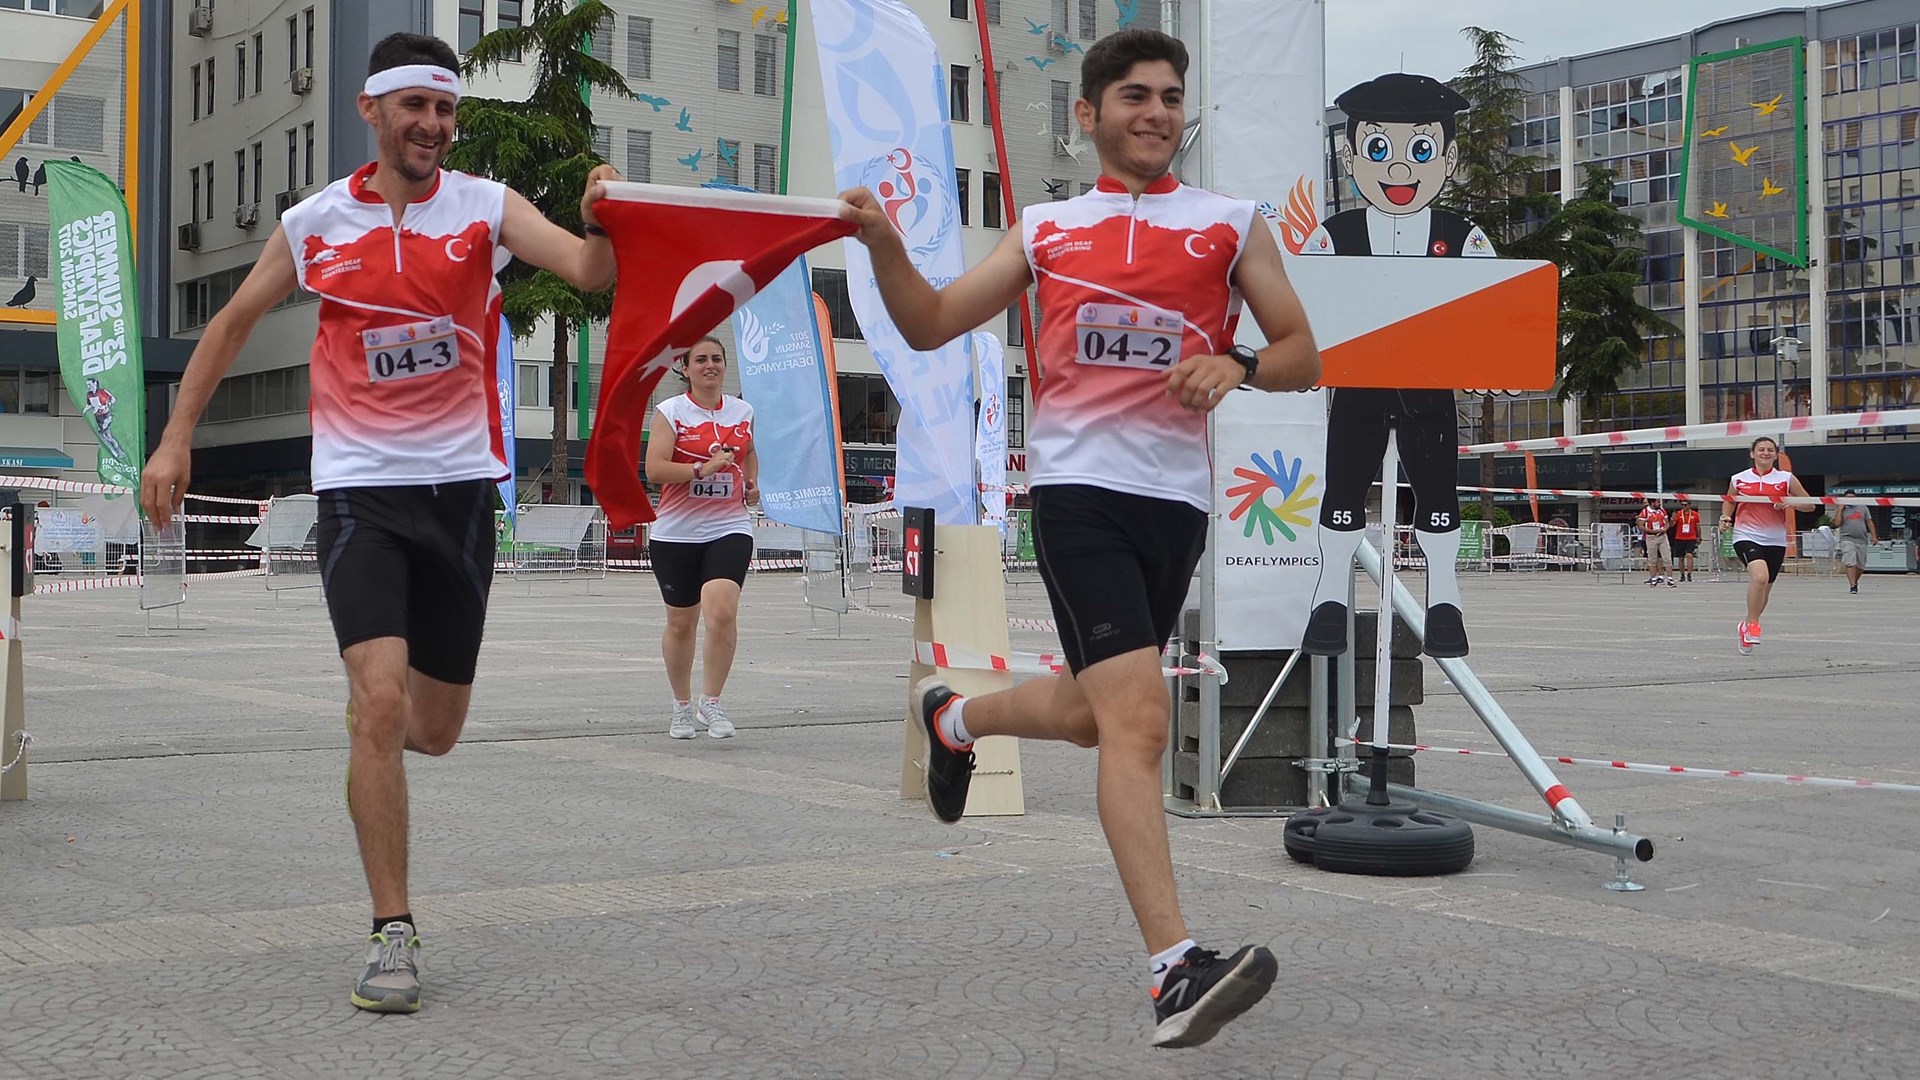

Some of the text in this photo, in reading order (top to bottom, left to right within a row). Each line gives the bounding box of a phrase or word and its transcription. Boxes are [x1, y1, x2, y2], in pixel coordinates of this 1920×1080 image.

[1084, 331, 1172, 366] 04-2
[375, 341, 452, 377] 04-3
[1519, 463, 1556, 475] TRAN
[1576, 459, 1630, 473] MEKEZİ
[693, 483, 728, 497] 04-1
[1332, 510, 1352, 525] 55
[1430, 512, 1451, 527] 55
[1225, 556, 1319, 567] DEAFLYMPICS
